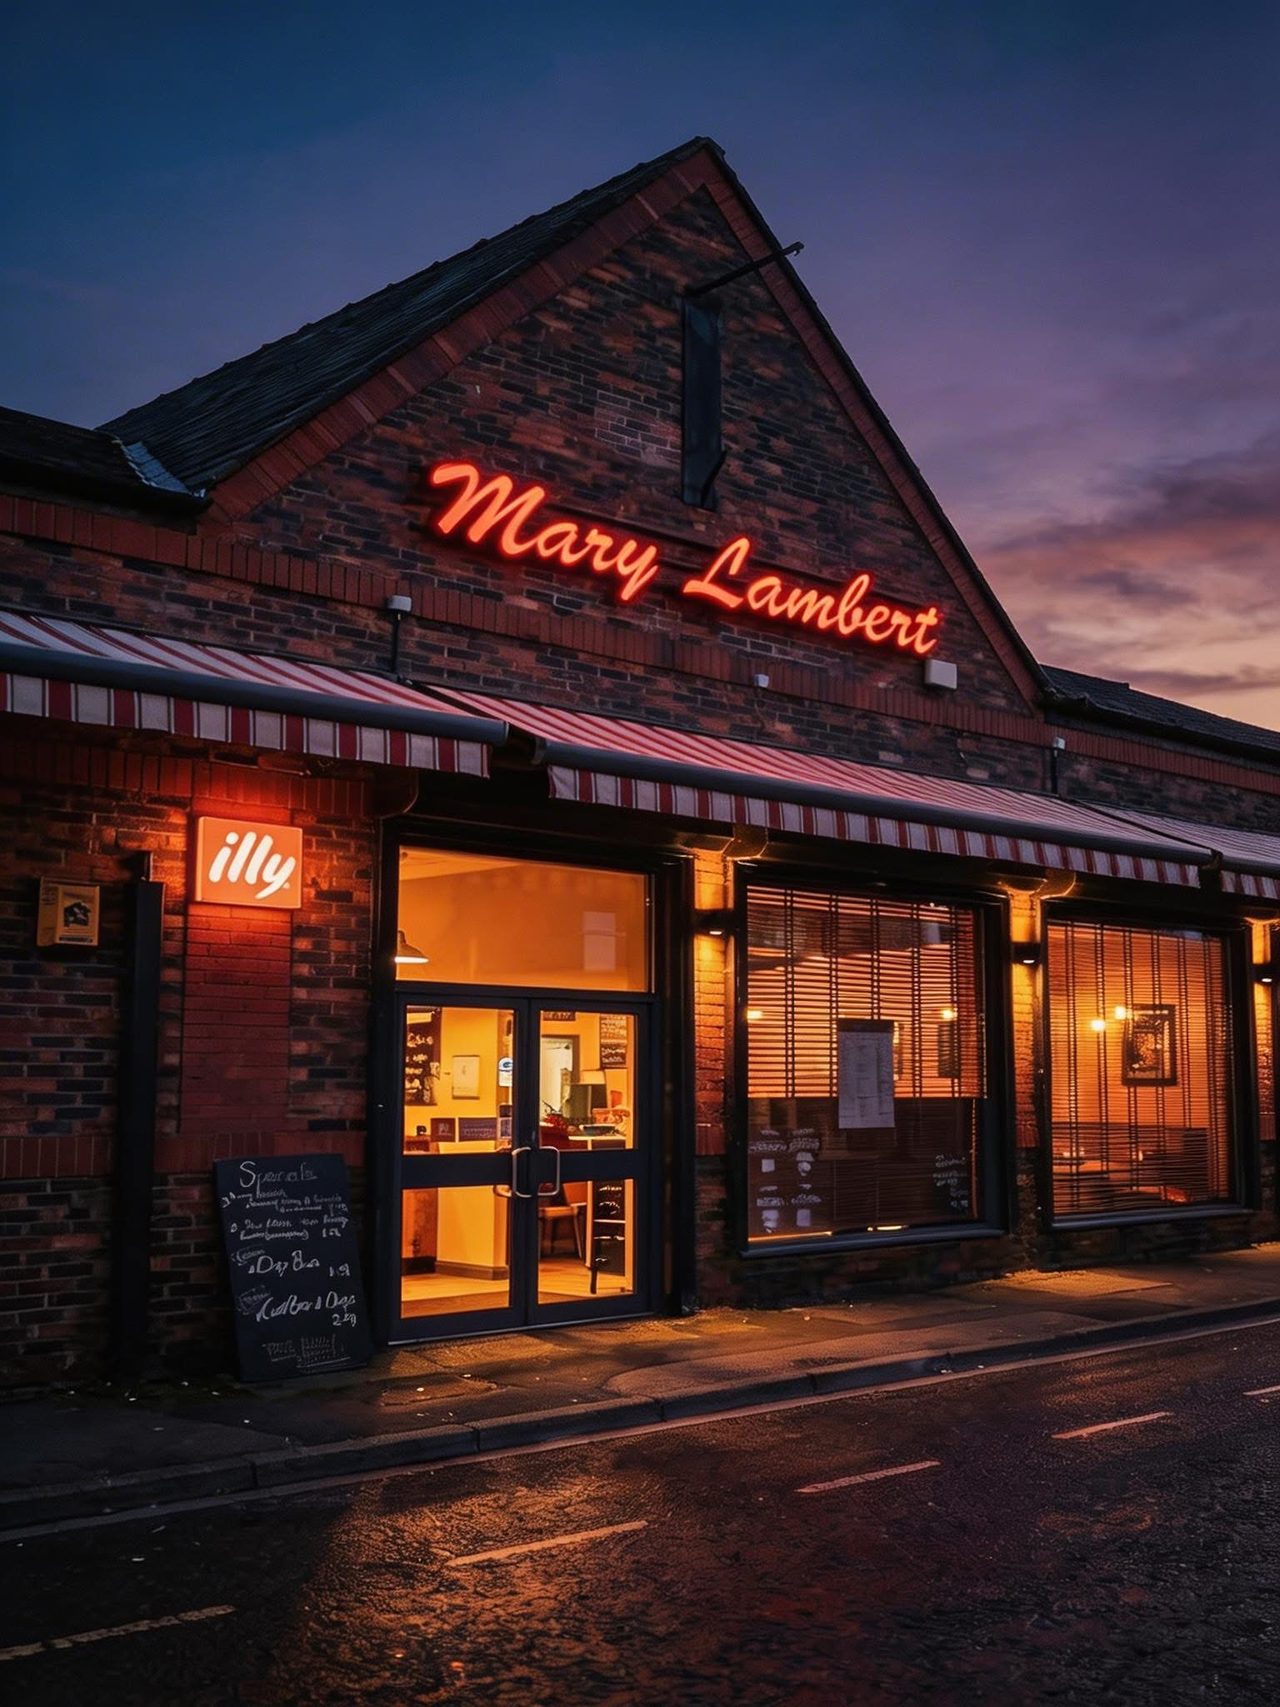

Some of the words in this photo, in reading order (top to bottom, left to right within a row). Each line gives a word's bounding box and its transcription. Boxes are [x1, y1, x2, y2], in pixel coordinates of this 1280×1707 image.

[432, 463, 660, 601] Mary
[682, 536, 938, 653] Lambert
[209, 831, 296, 899] illy
